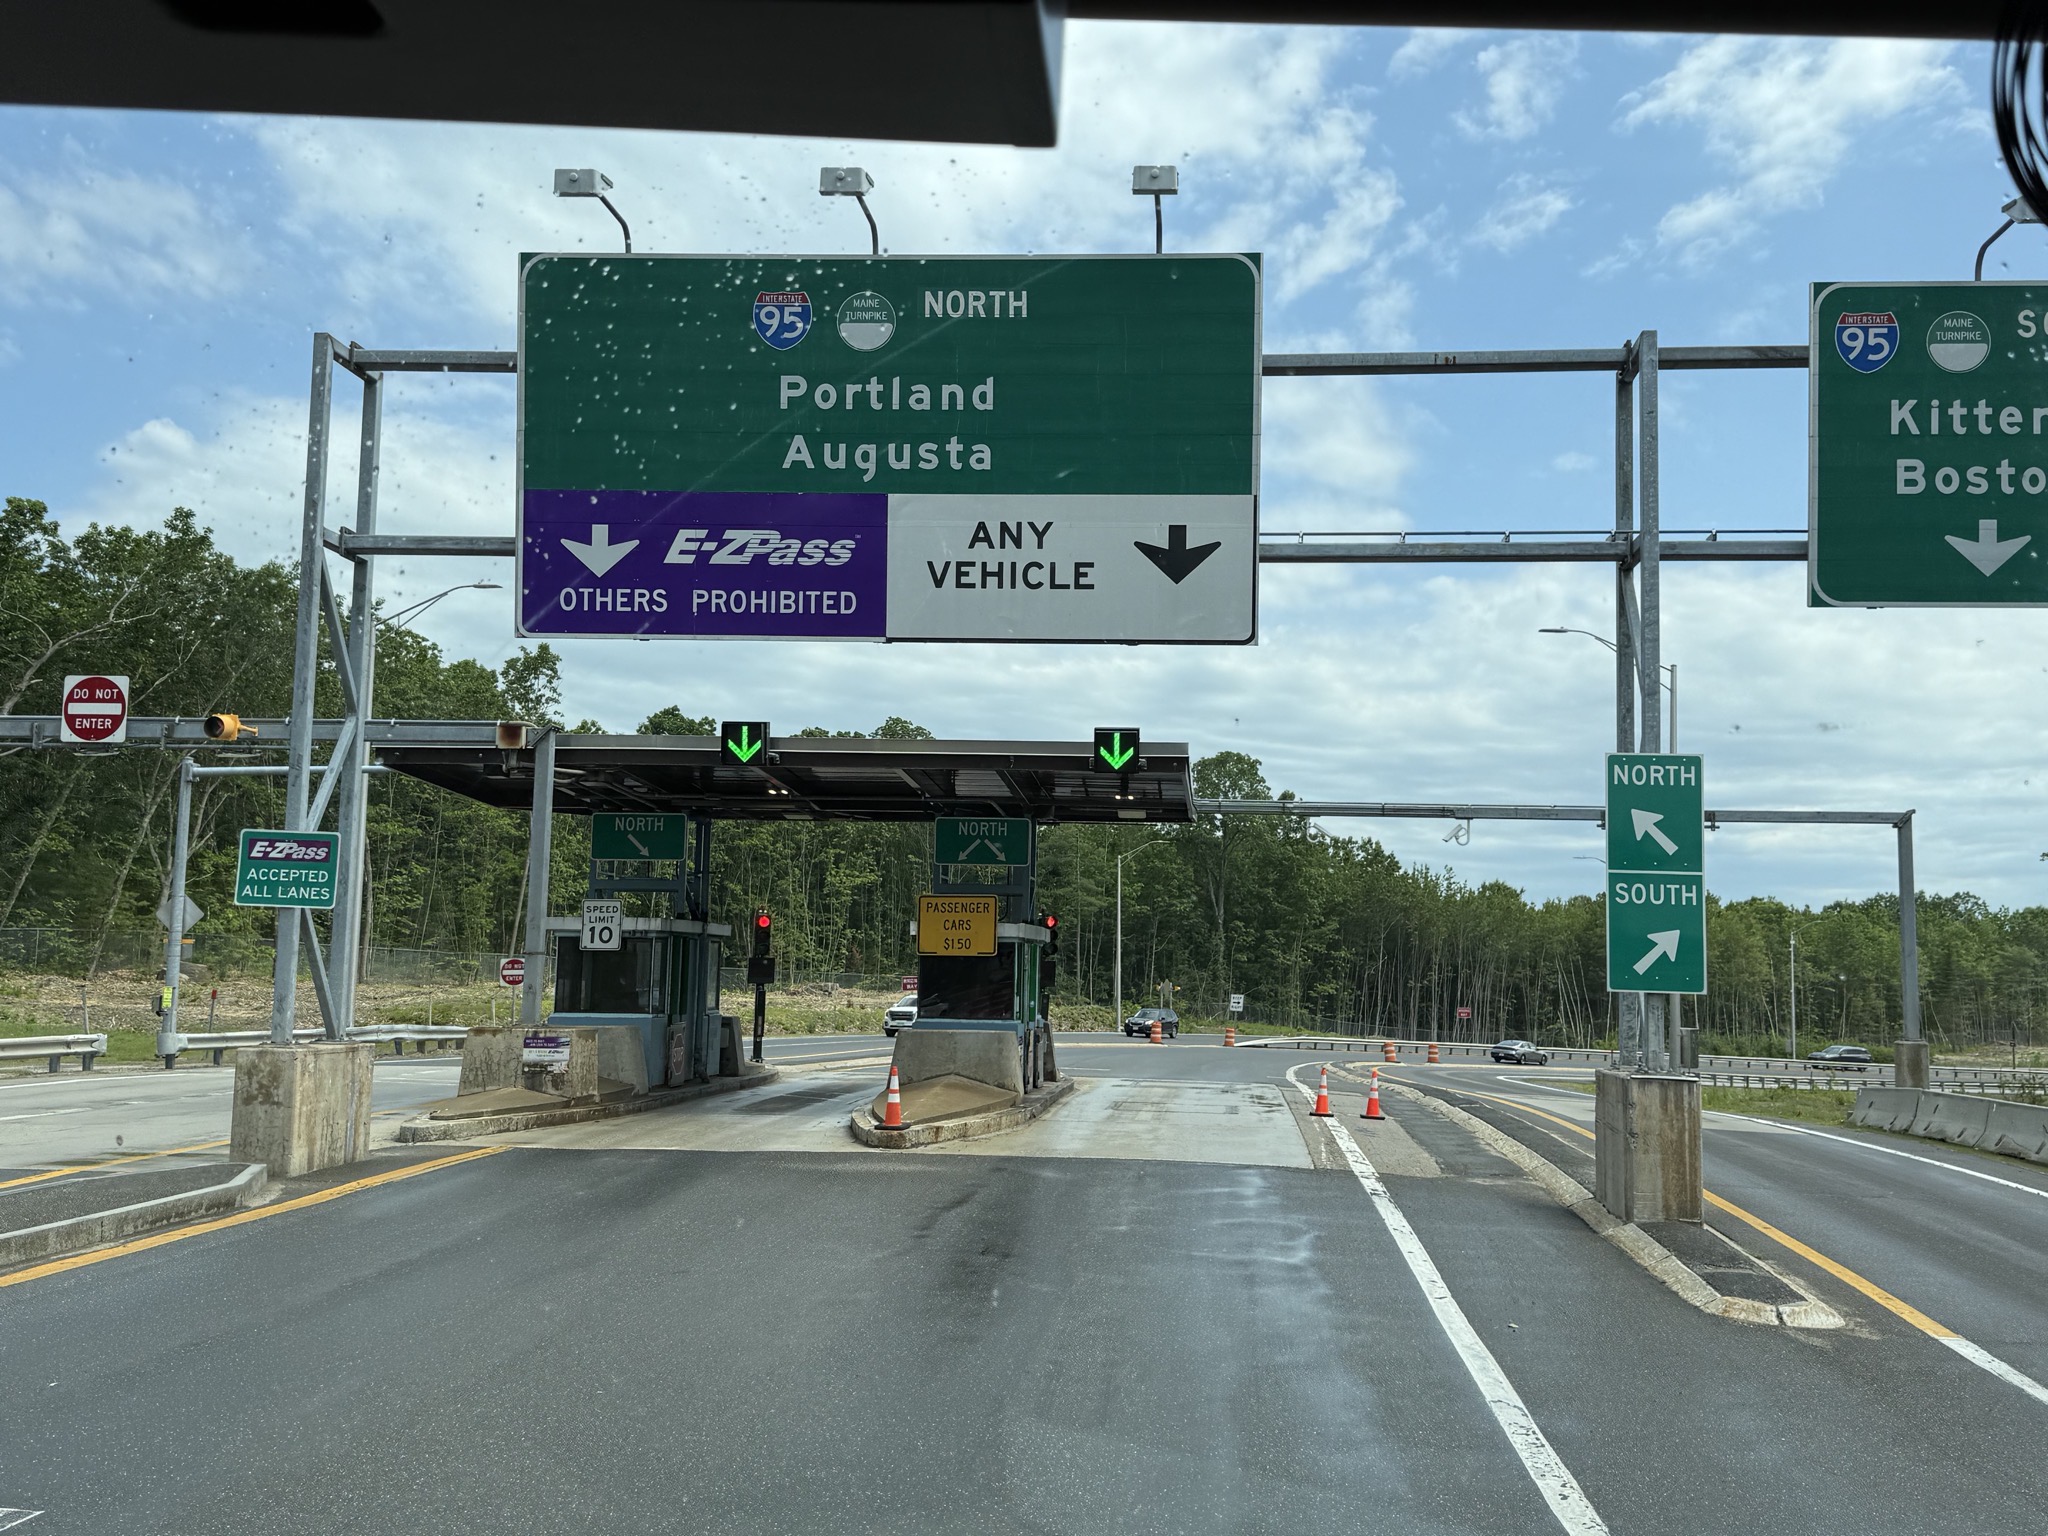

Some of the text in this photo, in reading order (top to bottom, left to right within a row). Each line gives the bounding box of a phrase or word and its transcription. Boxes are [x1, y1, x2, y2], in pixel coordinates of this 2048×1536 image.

[762, 294, 803, 303] INTERSTATE
[853, 299, 880, 308] MAINE
[924, 290, 1028, 319] NORTH
[759, 305, 804, 338] 95
[846, 311, 888, 321] TURNPIKE
[1845, 315, 1889, 325] INTERSTATE
[1944, 318, 1973, 328] MAINE
[2017, 309, 2048, 338] S
[1841, 327, 1890, 361] 95
[1936, 331, 1982, 341] TURNPIKE
[780, 375, 994, 411] Portland
[1890, 399, 2048, 435] Kitter
[782, 434, 992, 483] Augusta
[1896, 458, 2047, 495] Bosto
[968, 521, 1054, 550] ANY
[663, 529, 856, 566] E-ZPass
[927, 561, 1095, 590] VEHICLE
[559, 587, 857, 615] OTHERS PROHIBITED
[73, 688, 119, 700] DO NOT
[75, 718, 112, 729] ENTER
[1613, 764, 1696, 786] NORTH
[615, 817, 664, 831] NORTH
[958, 821, 1008, 836] NORTH
[250, 841, 329, 860] E-ZPass
[246, 867, 329, 883] ACCEPTED
[241, 884, 330, 900] ALL LANES
[1615, 883, 1697, 906] SOUTH
[585, 905, 619, 914] SPEED
[926, 902, 990, 914] PASSENGER
[588, 915, 615, 924] LIMIT
[943, 920, 972, 931] CARS
[588, 926, 613, 944] 10
